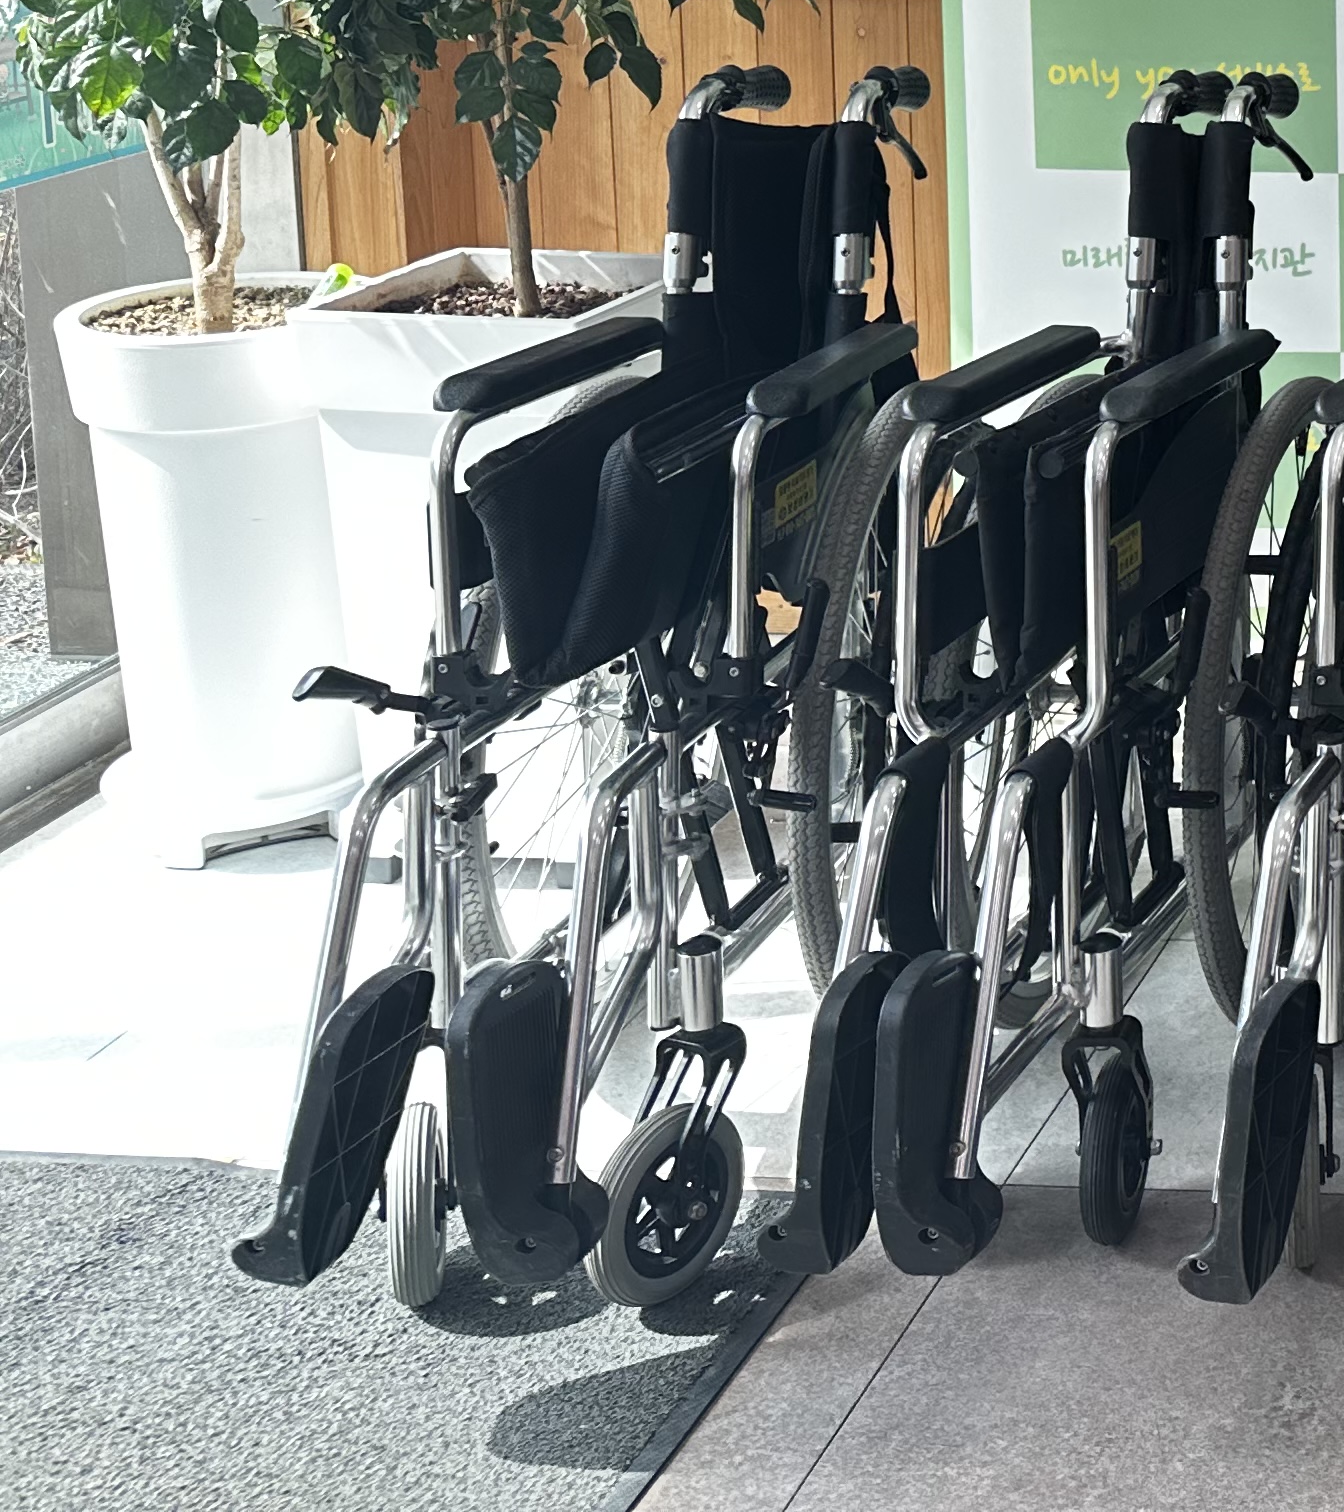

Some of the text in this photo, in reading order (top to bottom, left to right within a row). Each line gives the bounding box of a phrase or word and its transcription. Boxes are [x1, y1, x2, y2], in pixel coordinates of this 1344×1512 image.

[1048, 59, 1119, 98] only
[1062, 238, 1316, 278] 미래 지관
